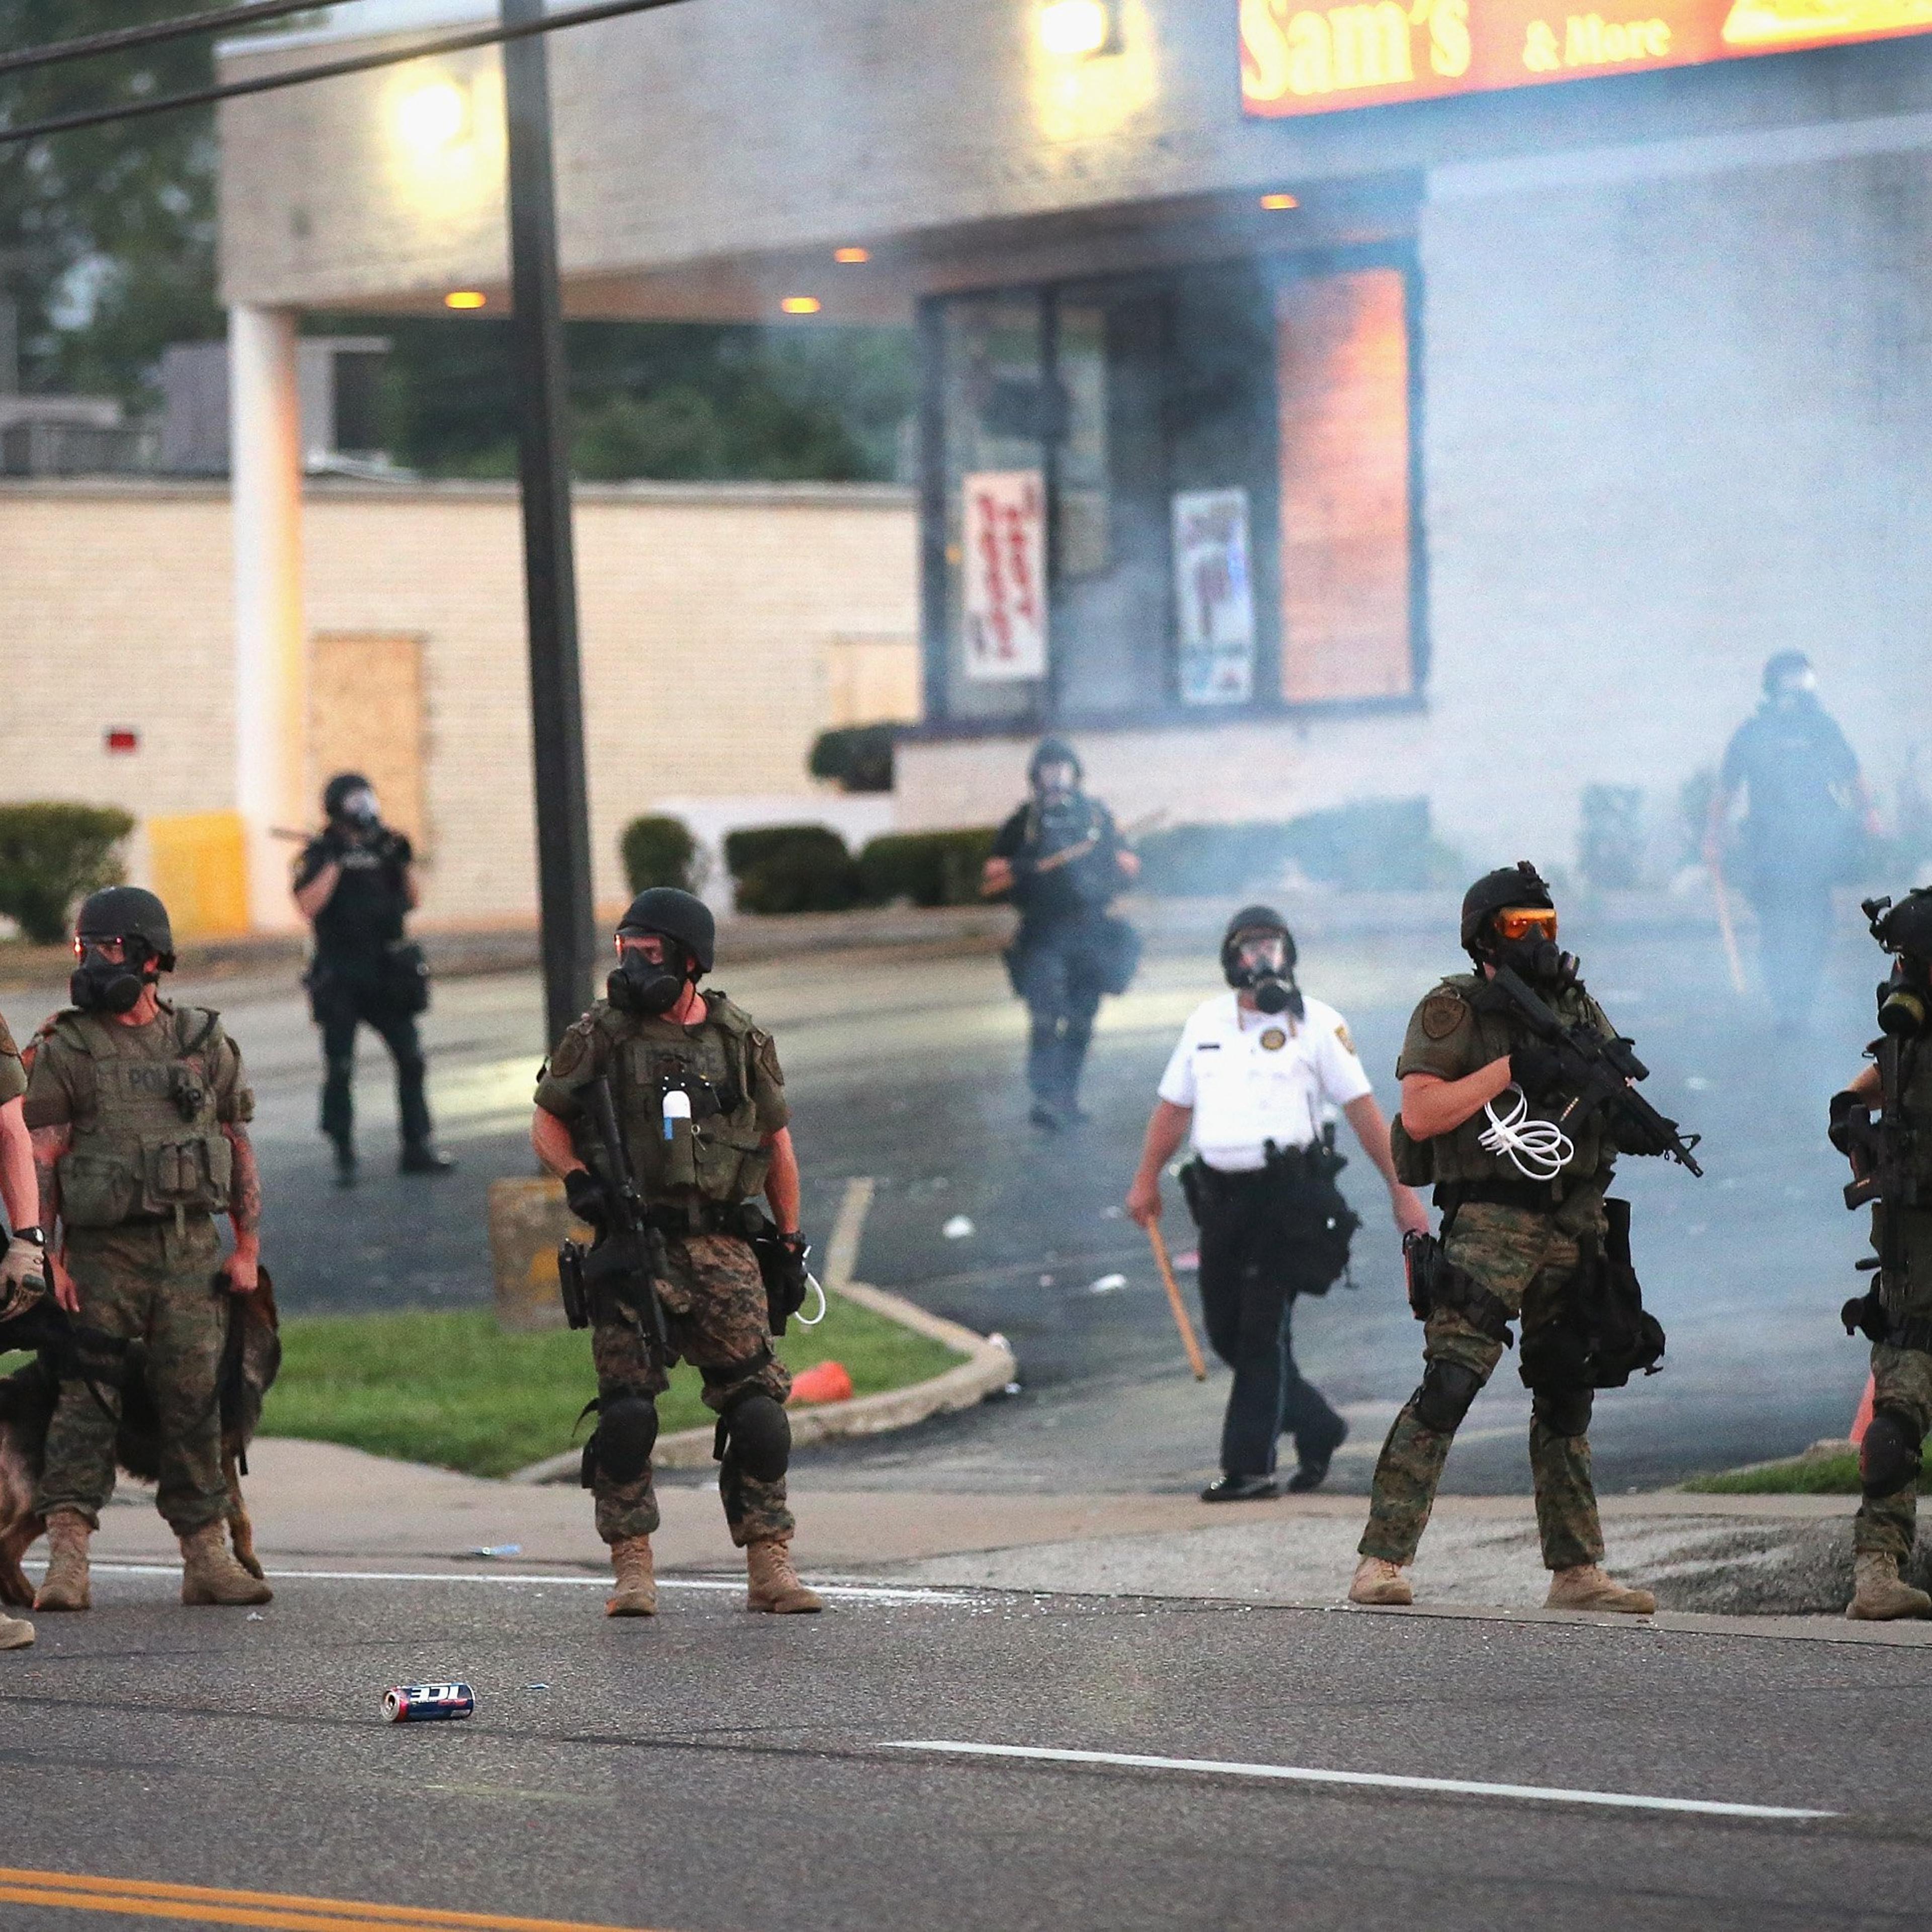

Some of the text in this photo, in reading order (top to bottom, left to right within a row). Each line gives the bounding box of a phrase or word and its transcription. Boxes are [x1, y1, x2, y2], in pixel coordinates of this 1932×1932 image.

[1240, 0, 1471, 101] Sam's
[1522, 12, 1671, 72] & More
[410, 1685, 459, 1701] ICE
